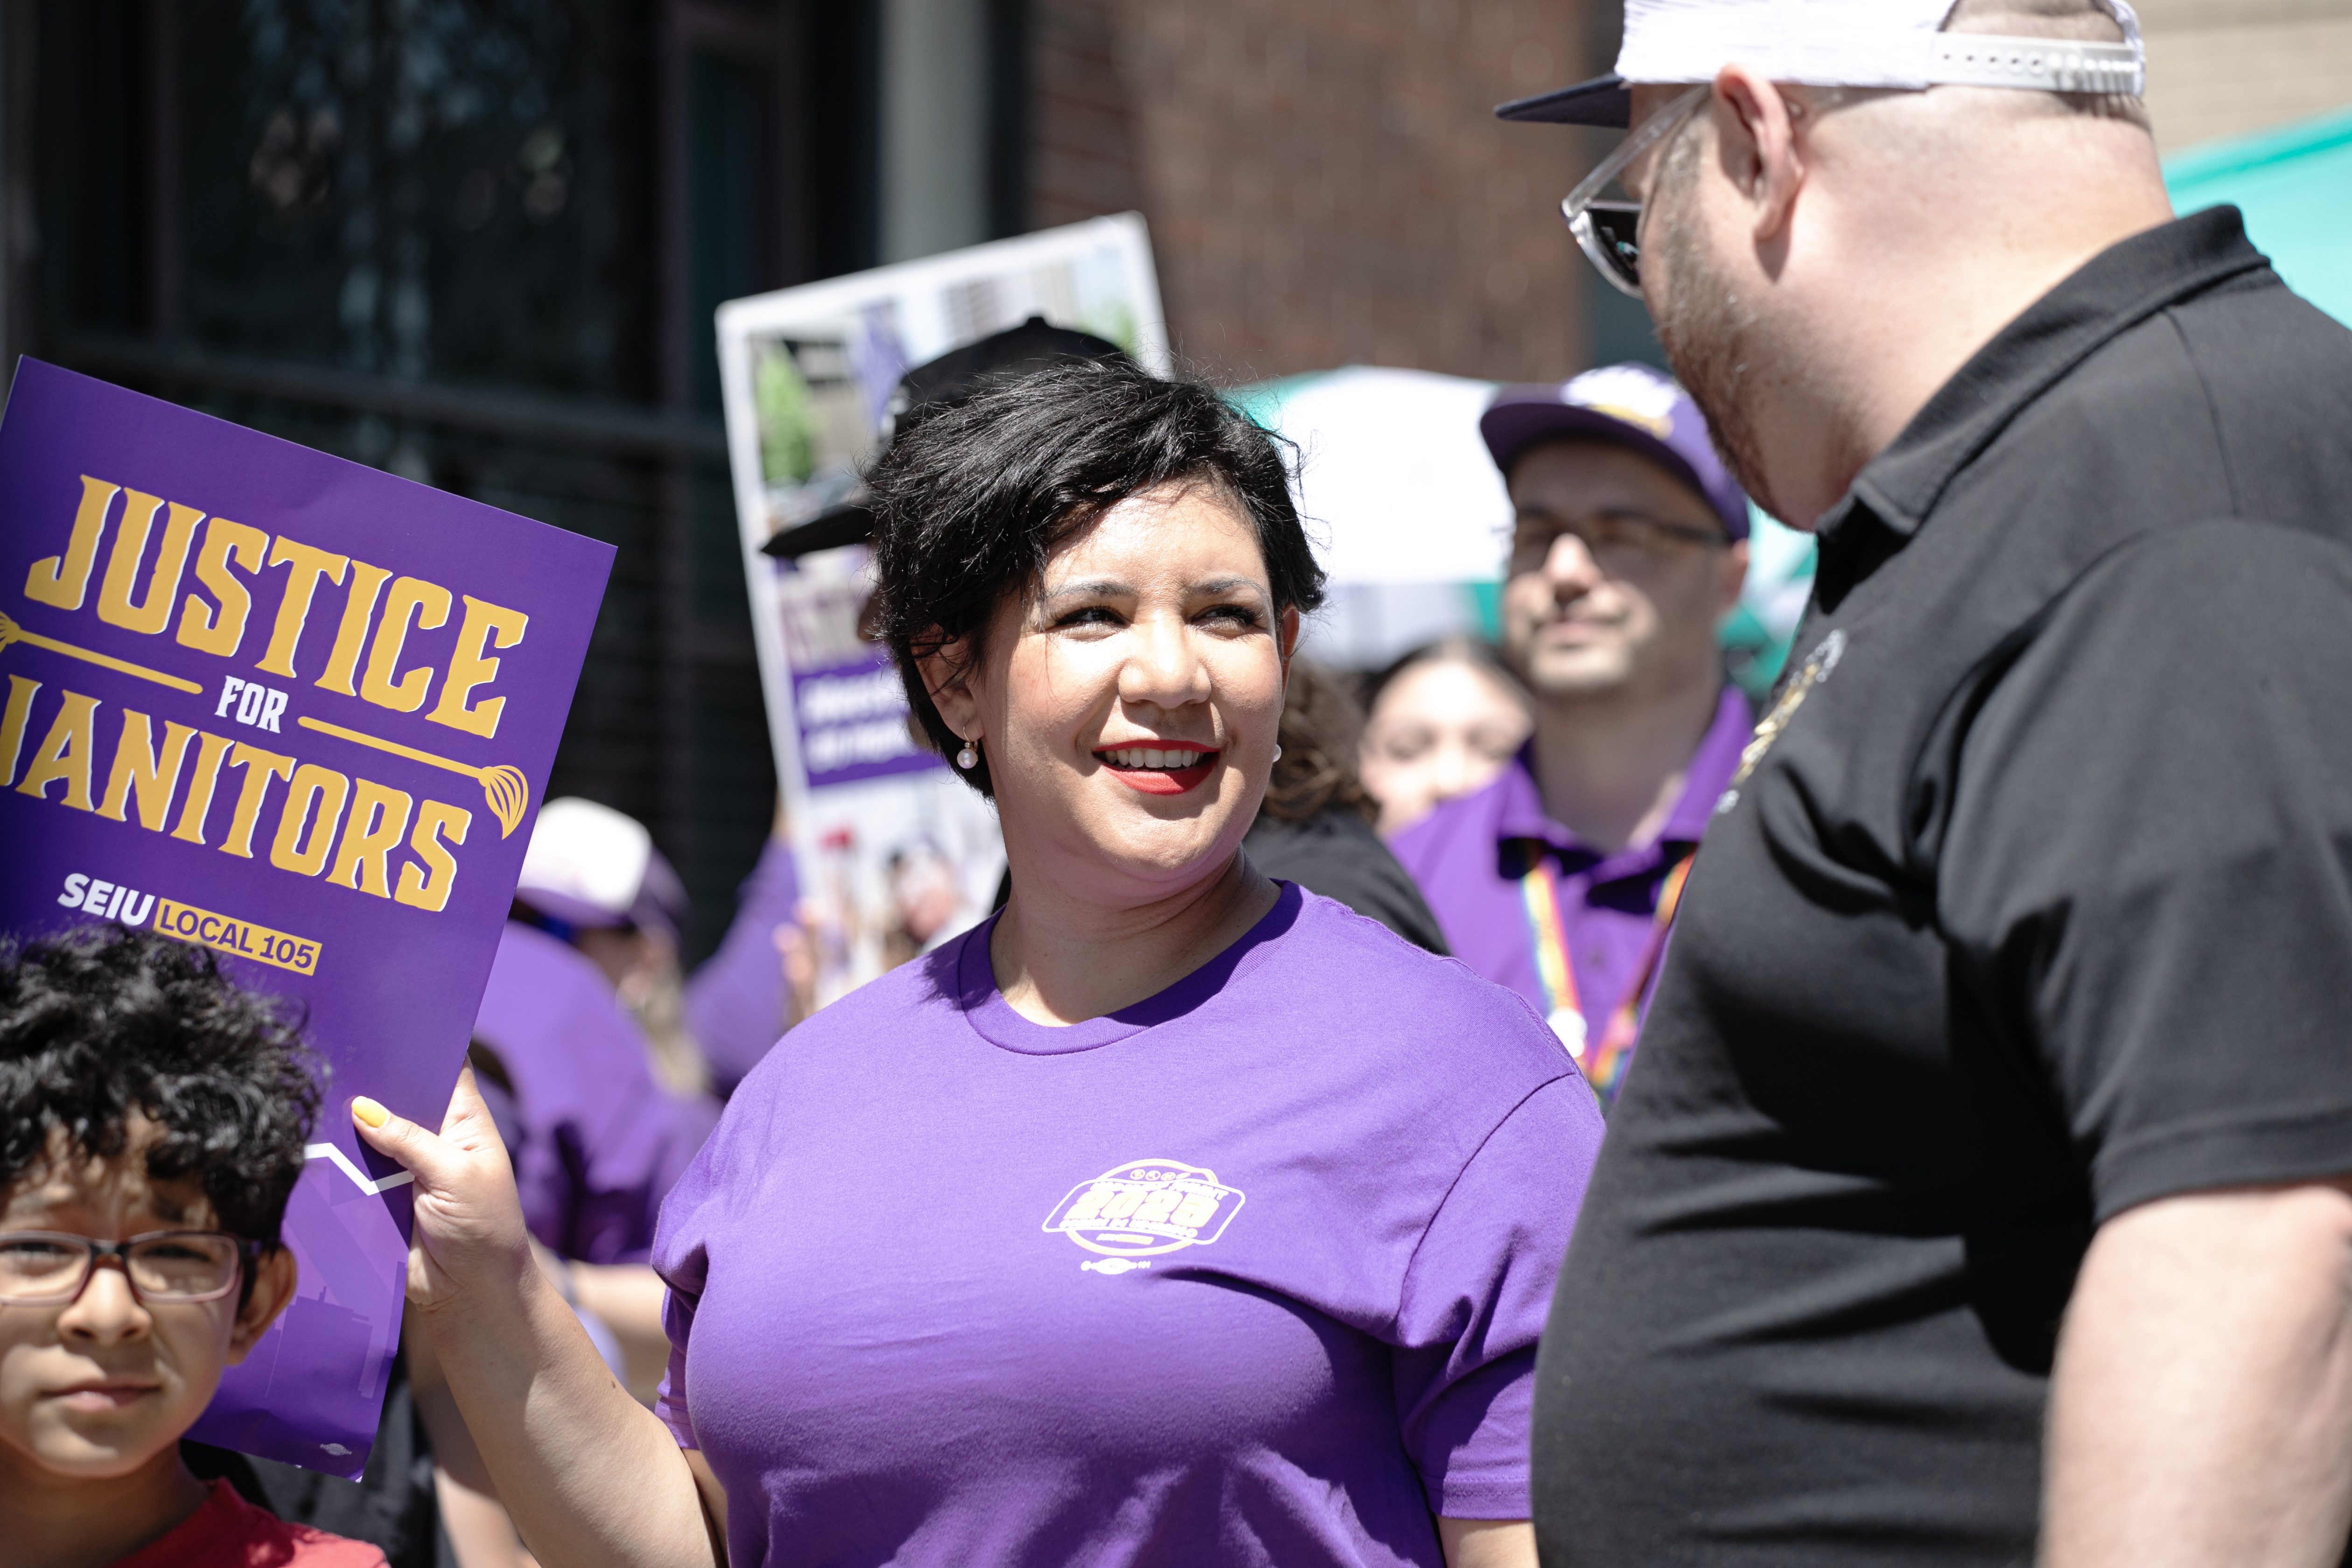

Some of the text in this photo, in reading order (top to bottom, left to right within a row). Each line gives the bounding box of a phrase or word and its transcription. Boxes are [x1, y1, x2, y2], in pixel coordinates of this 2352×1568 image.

[24, 474, 529, 739] JUSTICE
[214, 675, 289, 734] FOR
[57, 873, 316, 969] SEIU LOCAL 105
[1064, 1189, 1220, 1228] 2023
